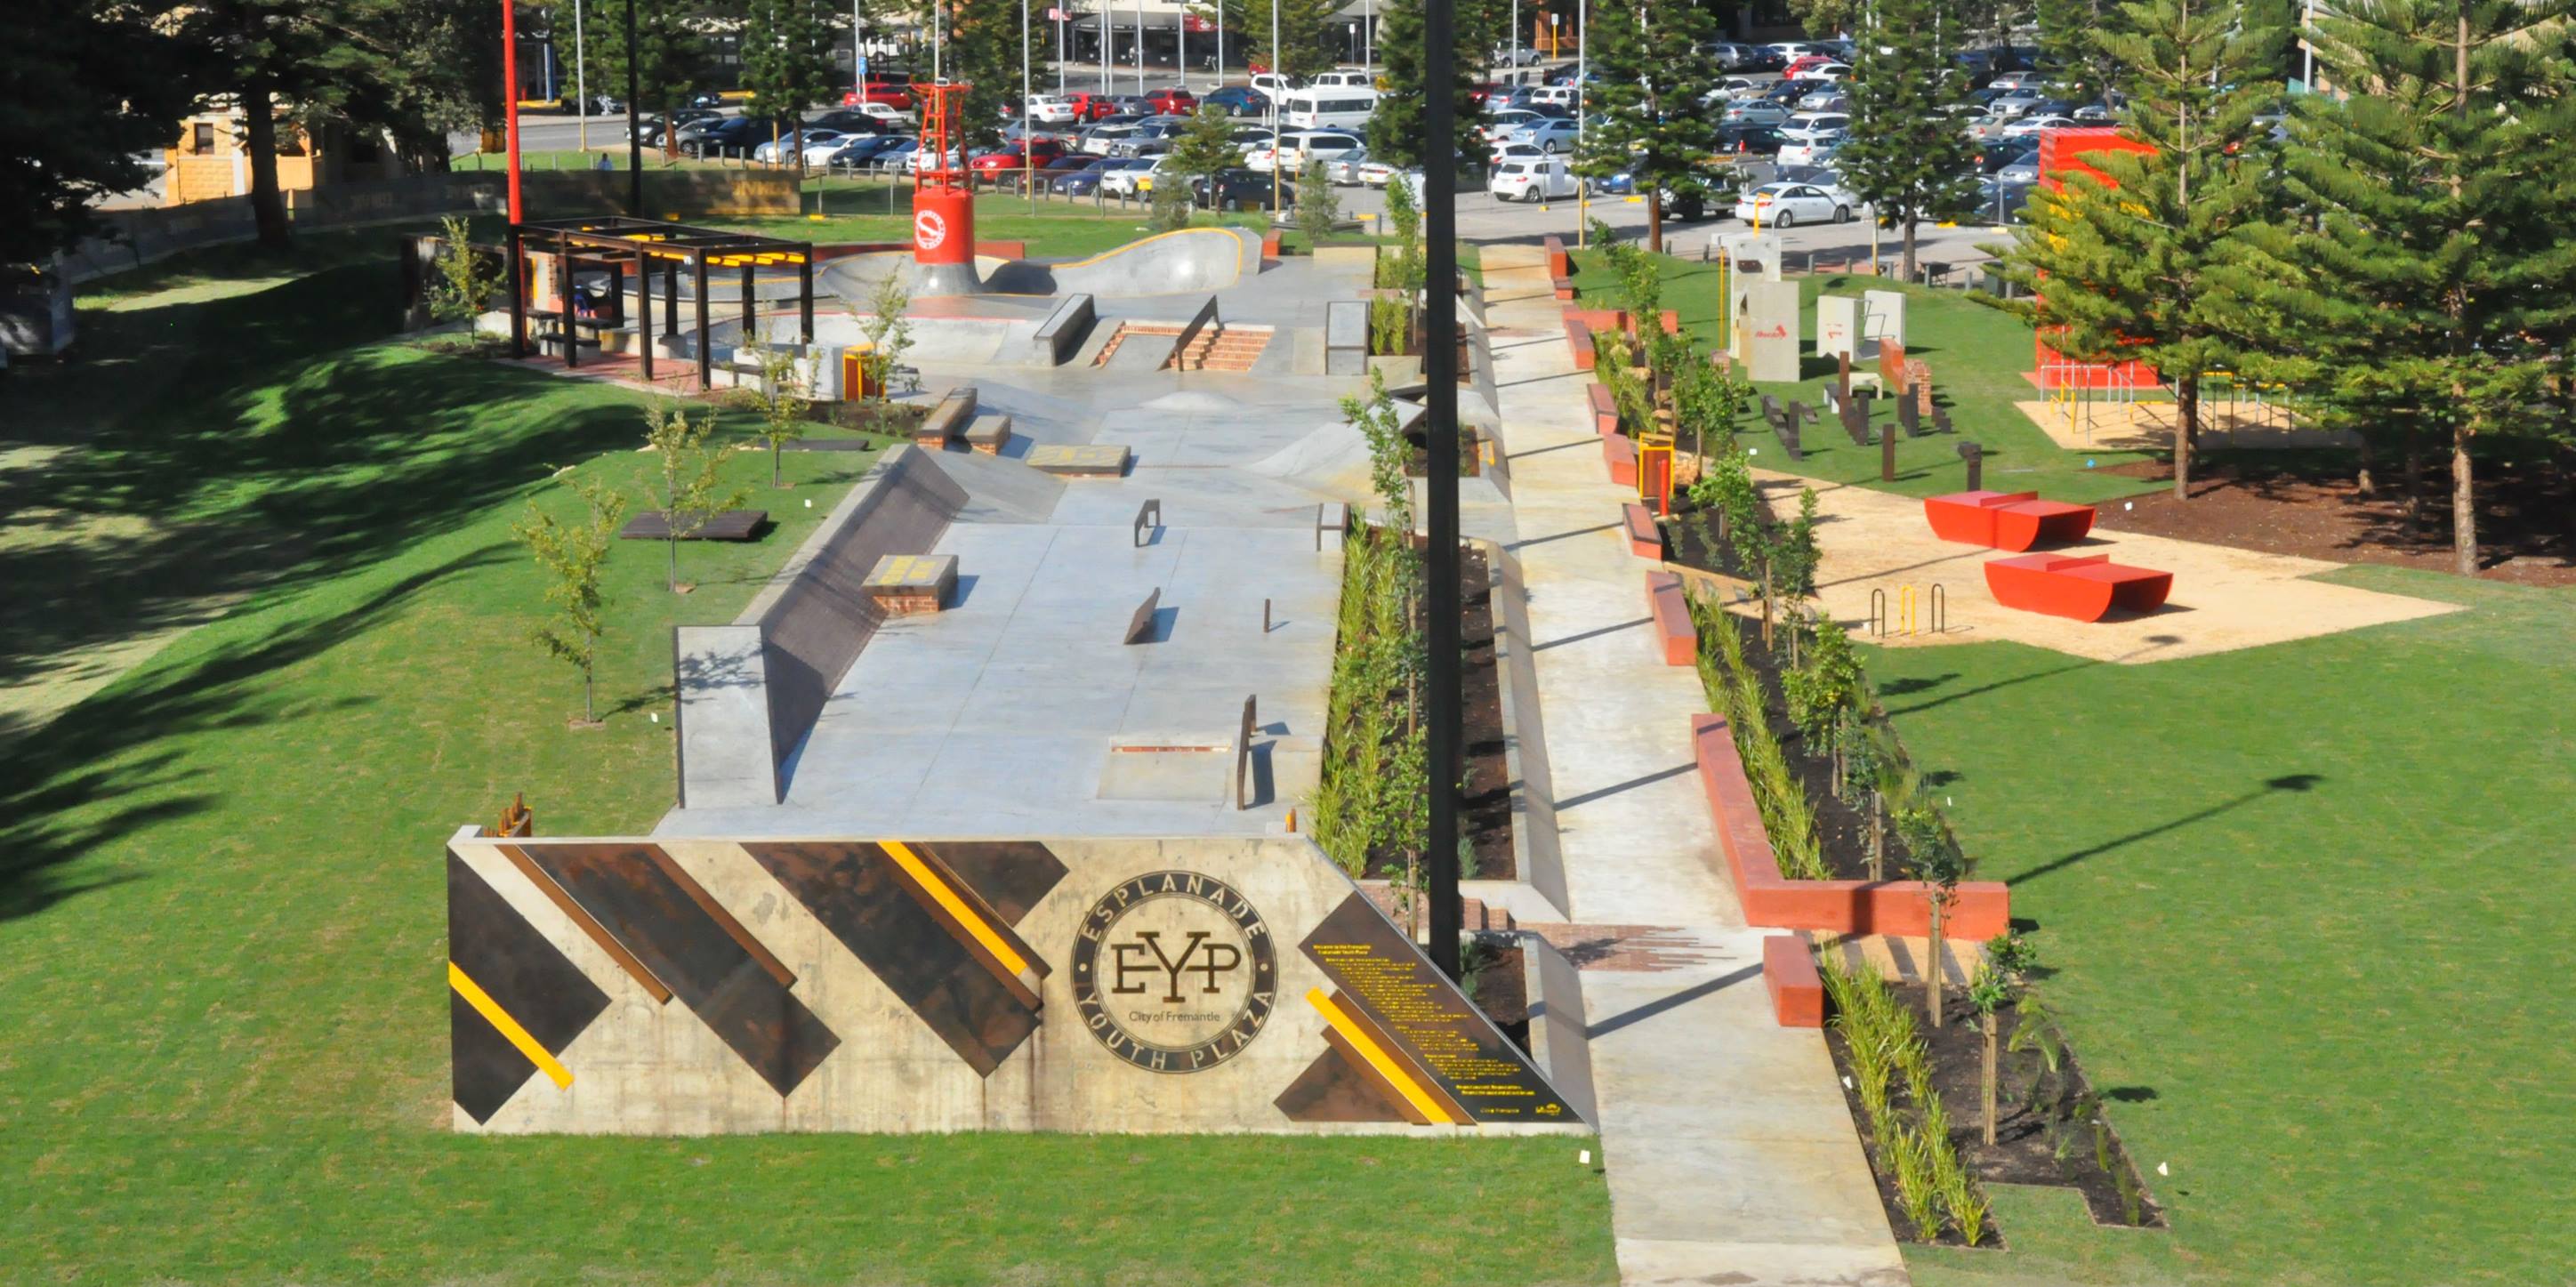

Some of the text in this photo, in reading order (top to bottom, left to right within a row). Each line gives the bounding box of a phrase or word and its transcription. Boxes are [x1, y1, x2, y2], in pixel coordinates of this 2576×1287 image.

[1082, 873, 1266, 942] ESPLANADE
[1110, 931, 1242, 1004] EYP
[1079, 992, 1167, 1070] YOUTH
[1189, 990, 1273, 1069] PLAZA
[1129, 1011, 1220, 1026] City of Fremantle
